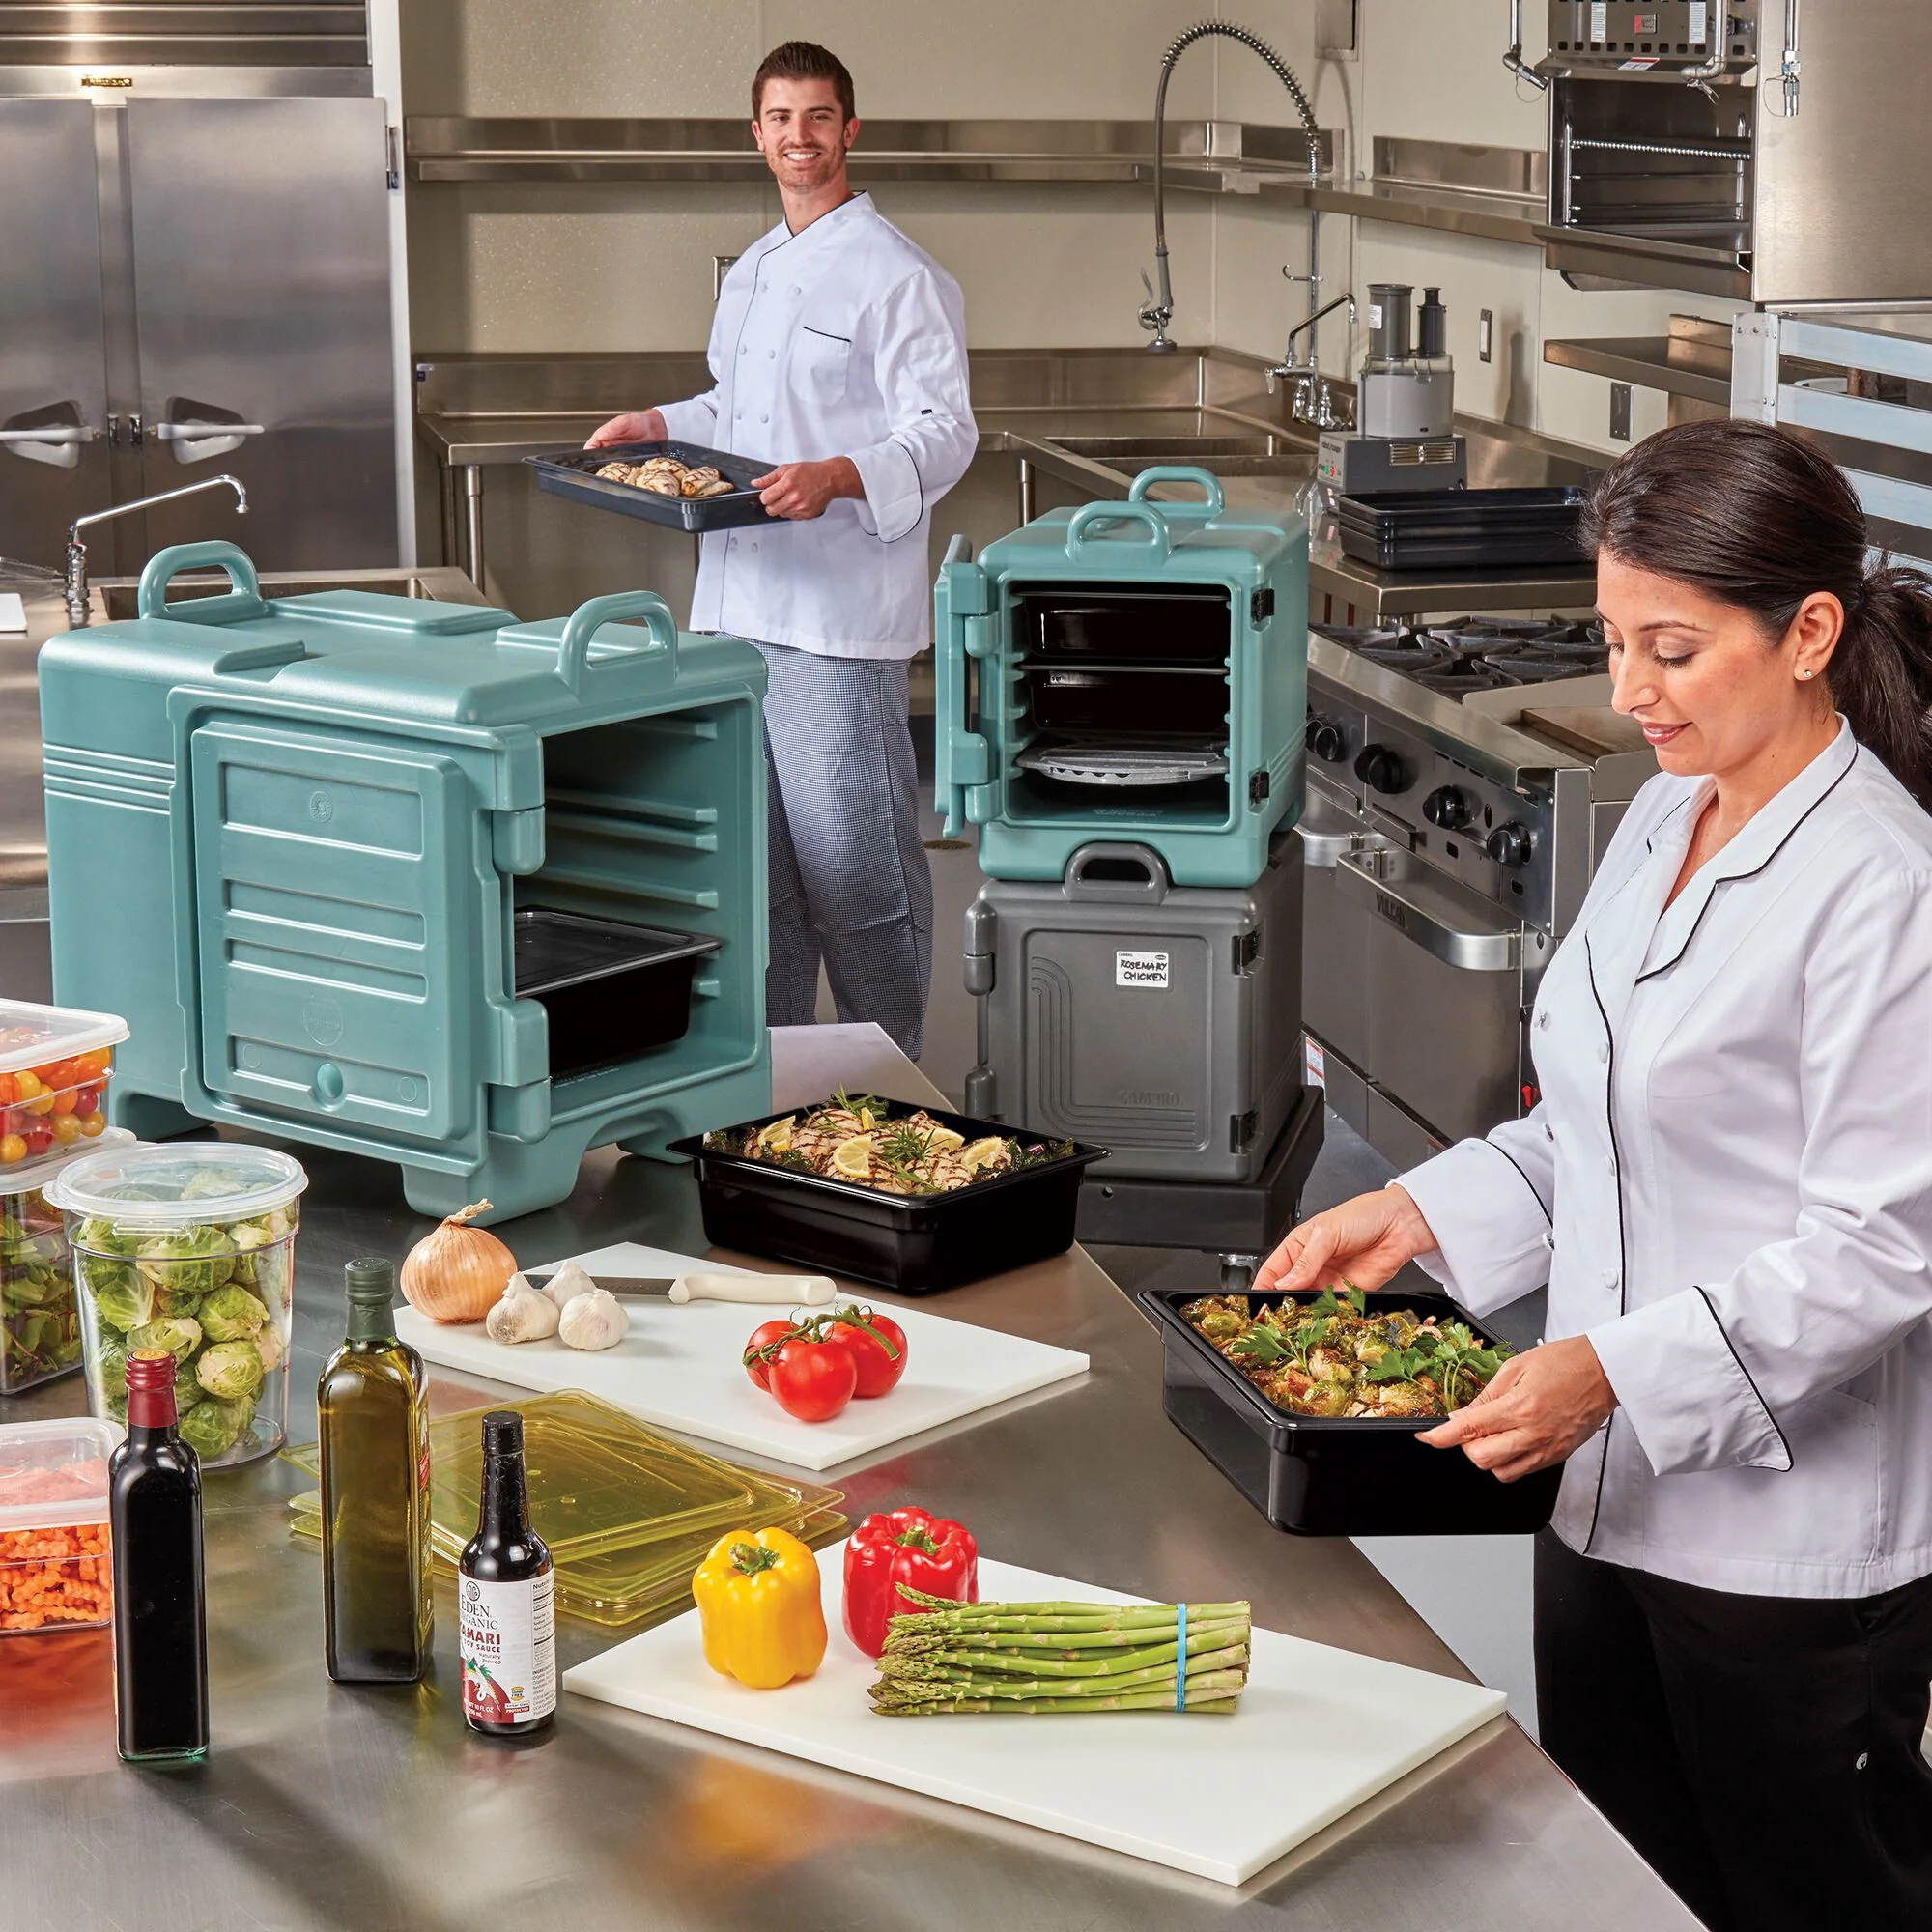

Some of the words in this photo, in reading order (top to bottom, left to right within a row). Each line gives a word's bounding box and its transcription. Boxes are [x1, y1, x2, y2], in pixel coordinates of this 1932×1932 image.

[1121, 959, 1167, 972] ROSEMARY
[1123, 971, 1166, 981] CHICKEN
[461, 1594, 490, 1617] EDEN
[460, 1622, 500, 1645] AMARI
[476, 1644, 500, 1653] SAUCE
